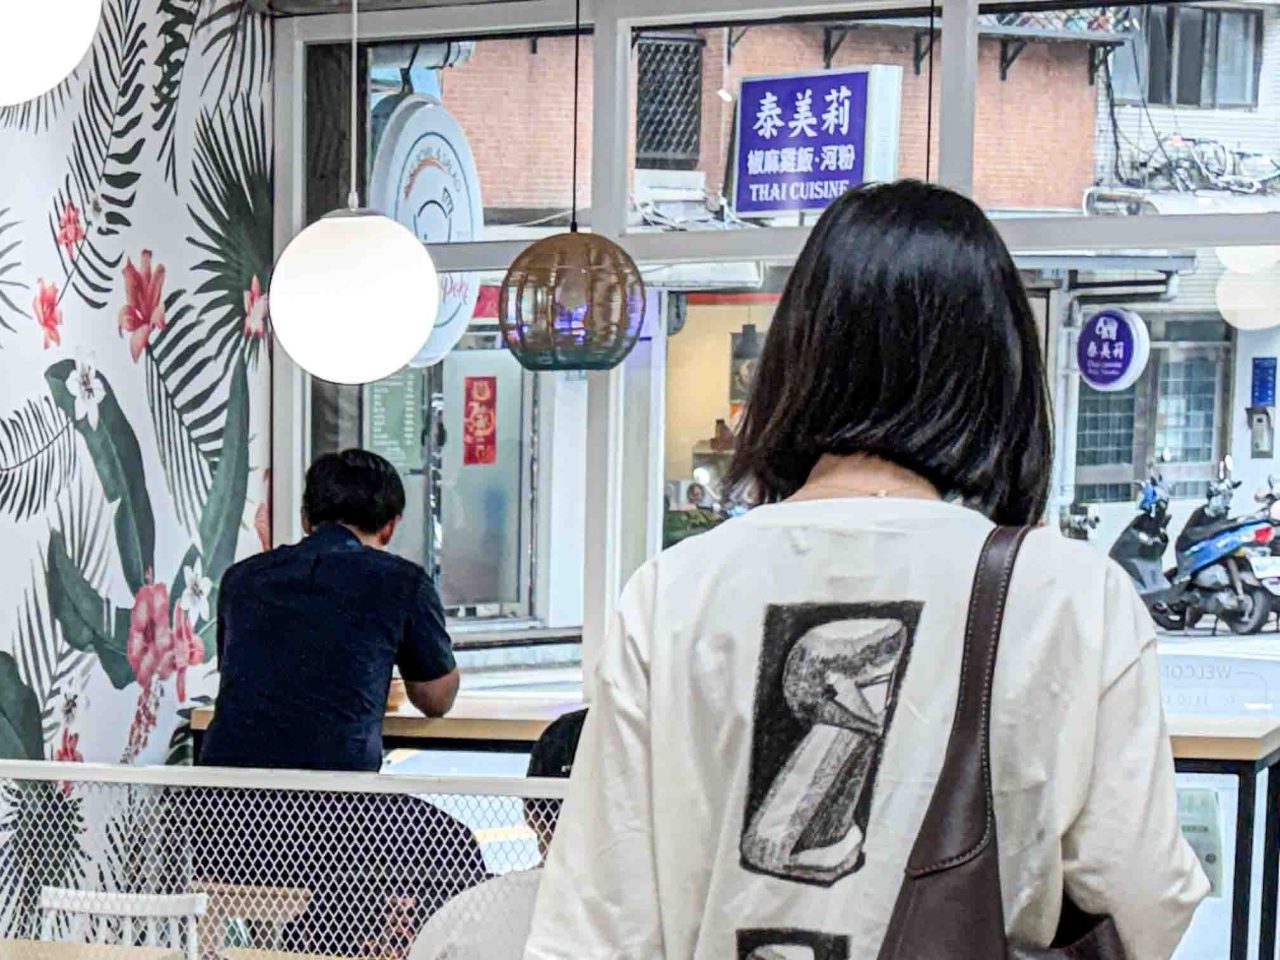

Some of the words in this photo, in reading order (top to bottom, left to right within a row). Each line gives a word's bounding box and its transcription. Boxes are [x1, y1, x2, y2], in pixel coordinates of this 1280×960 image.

[752, 85, 853, 140] 泰美莉
[749, 183, 787, 201] THAI
